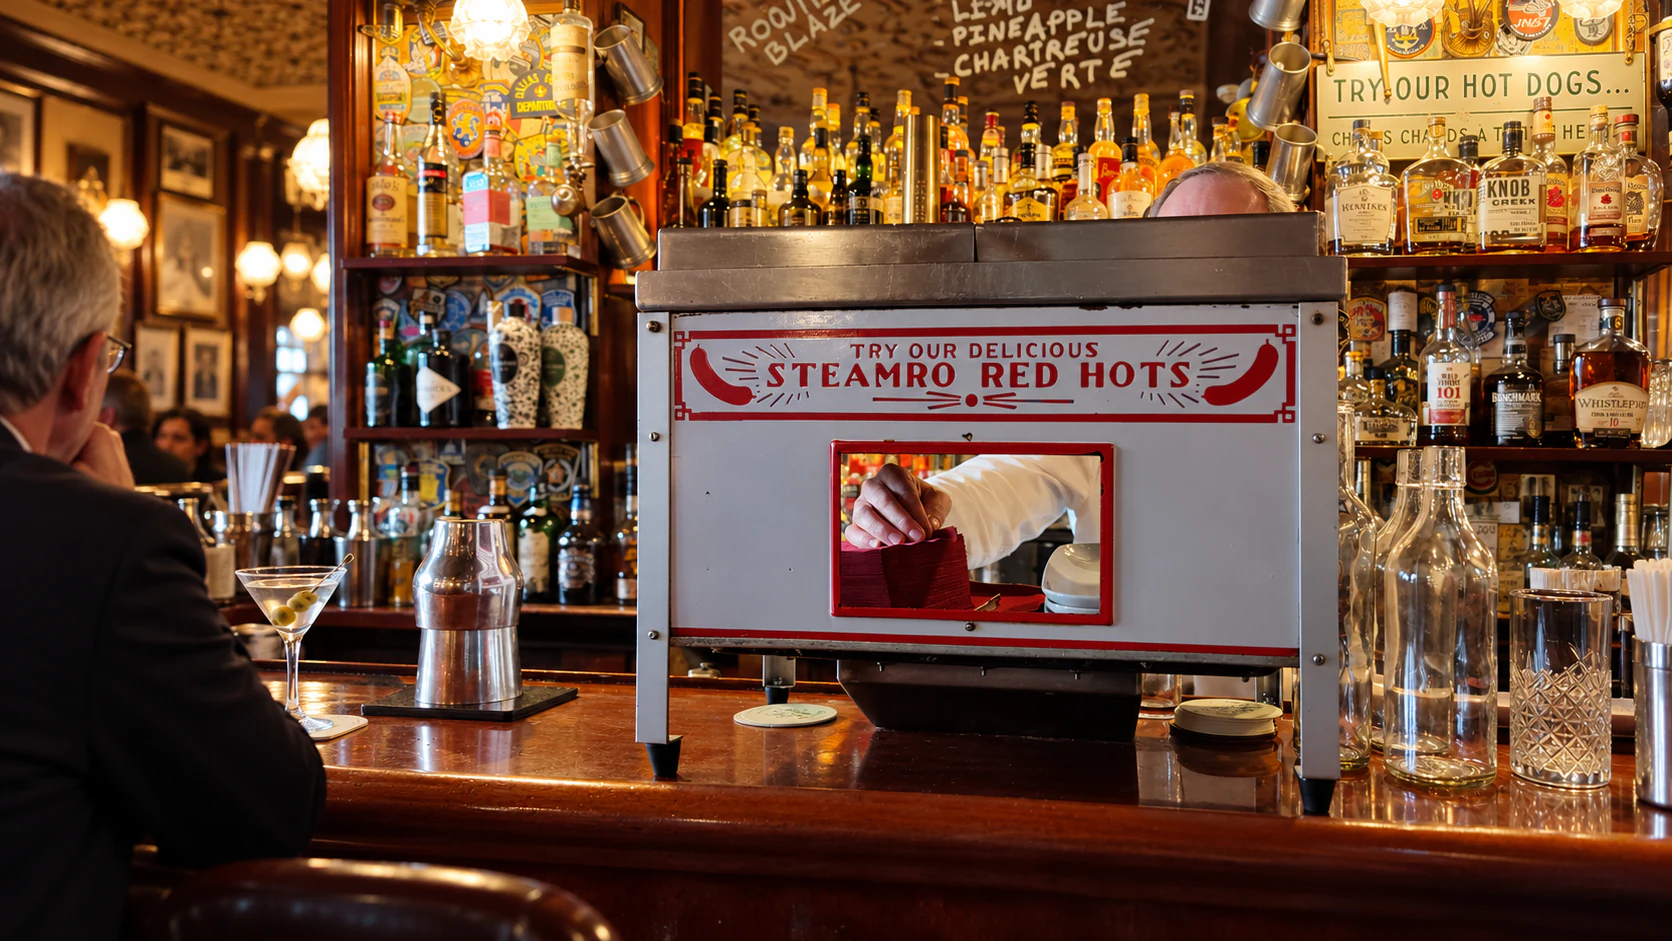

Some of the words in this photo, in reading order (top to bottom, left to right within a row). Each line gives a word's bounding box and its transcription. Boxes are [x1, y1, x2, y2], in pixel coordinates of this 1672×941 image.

[952, 2, 1126, 46] PINEAPPLE
[954, 18, 1155, 77] CHARTREUSE
[1013, 49, 1144, 94] VERTE
[1333, 78, 1383, 103] TRY
[1395, 75, 1450, 100] OUR
[1463, 73, 1513, 98] HOT
[1527, 70, 1629, 97] DOGS...
[1487, 178, 1531, 199] KNOB
[850, 343, 898, 360] TRY
[909, 342, 957, 359] OUR
[969, 342, 1099, 359] DELICIOUS
[766, 361, 956, 389] STEAMRO
[981, 361, 1059, 388] RED
[1080, 361, 1191, 388] HOTS
[1437, 386, 1461, 399] 101
[1609, 417, 1620, 427] 10
